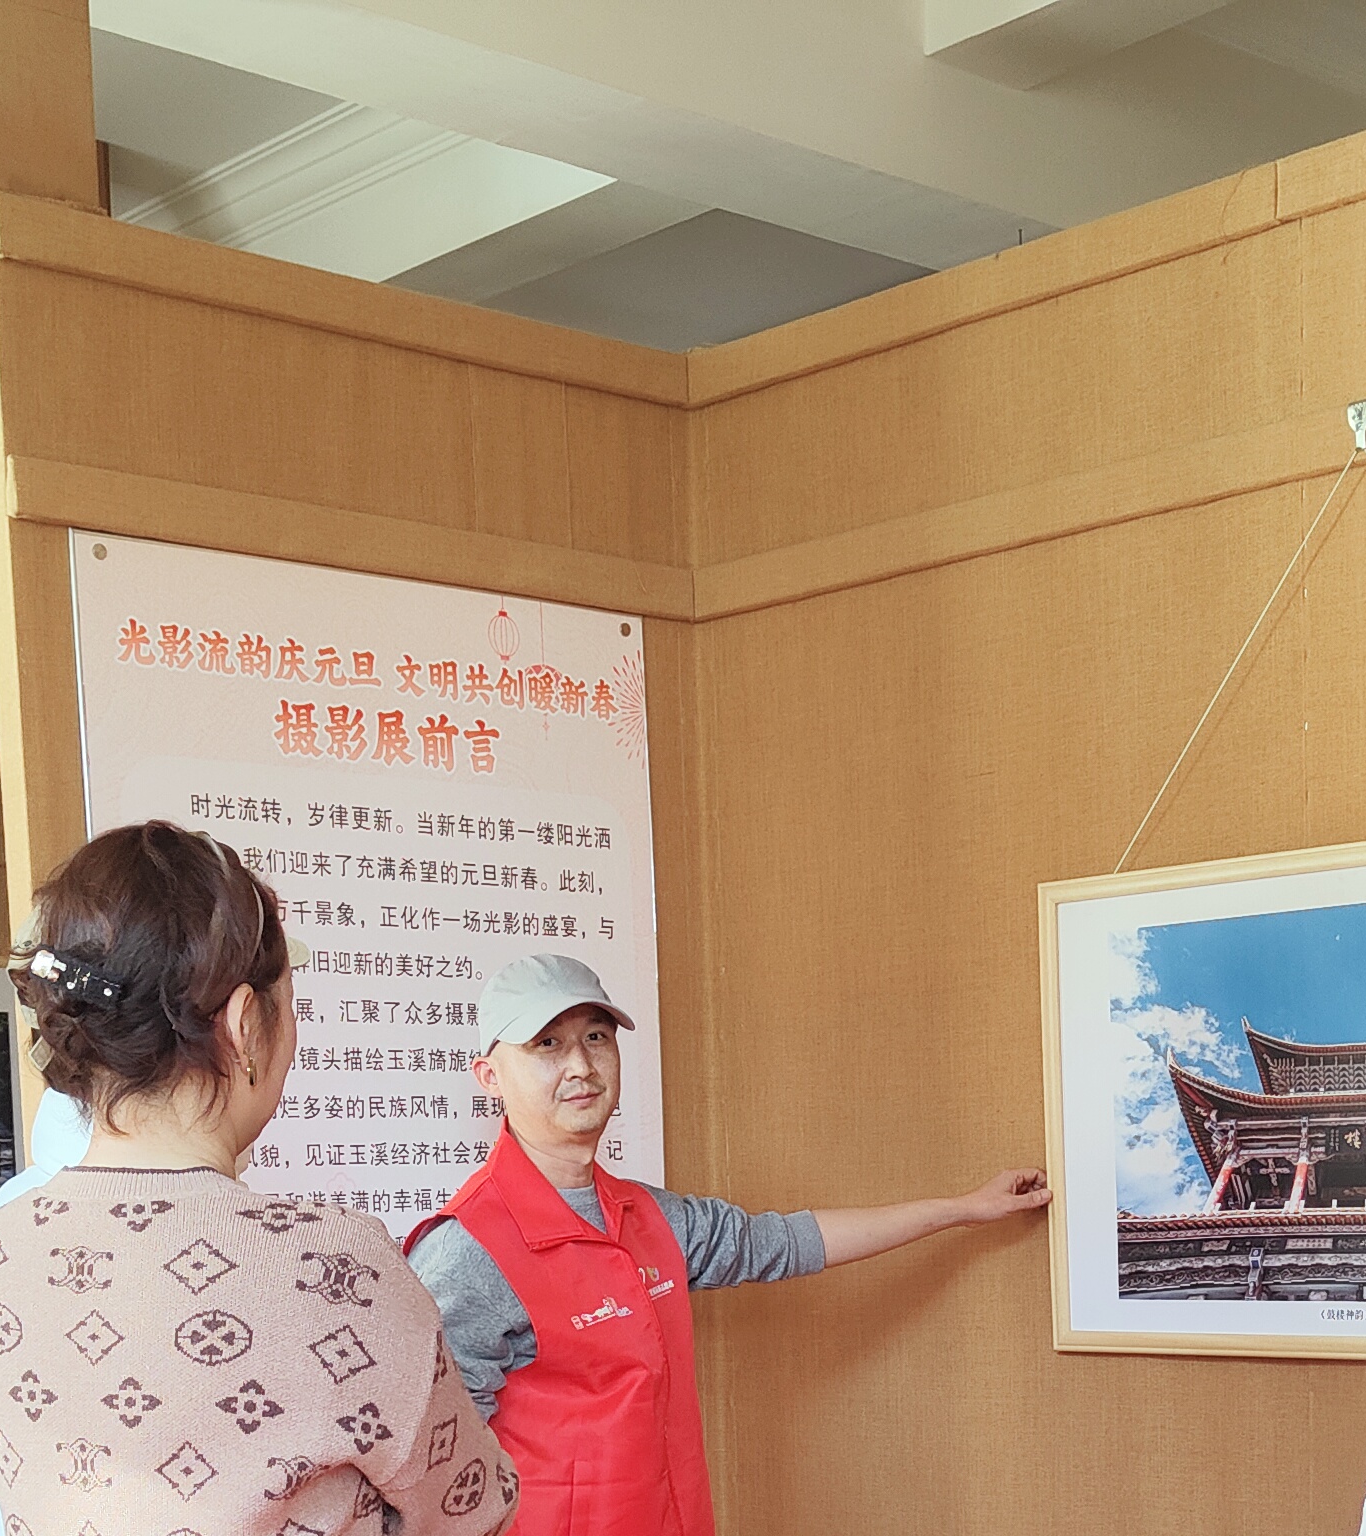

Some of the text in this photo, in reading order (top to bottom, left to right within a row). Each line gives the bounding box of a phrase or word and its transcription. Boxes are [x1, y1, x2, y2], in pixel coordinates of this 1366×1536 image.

[117, 618, 620, 721] 光影流韵庆元旦 文明共创暖新春
[273, 698, 501, 775] 摄影展前言
[190, 793, 612, 850] 时光流转，岁律更新。当新年的第一缕阳光洒
[243, 847, 604, 896] 我们迎来了充满希望的元旦新春。此刻，
[292, 949, 485, 981] 旧迎新的美好之约。
[291, 1046, 481, 1073] 镜头描绘玉溪旖旎
[272, 1094, 507, 1120] 烂多姿的民族风情，展现
[248, 1140, 498, 1169] 貌，见证玉溪经济社会发
